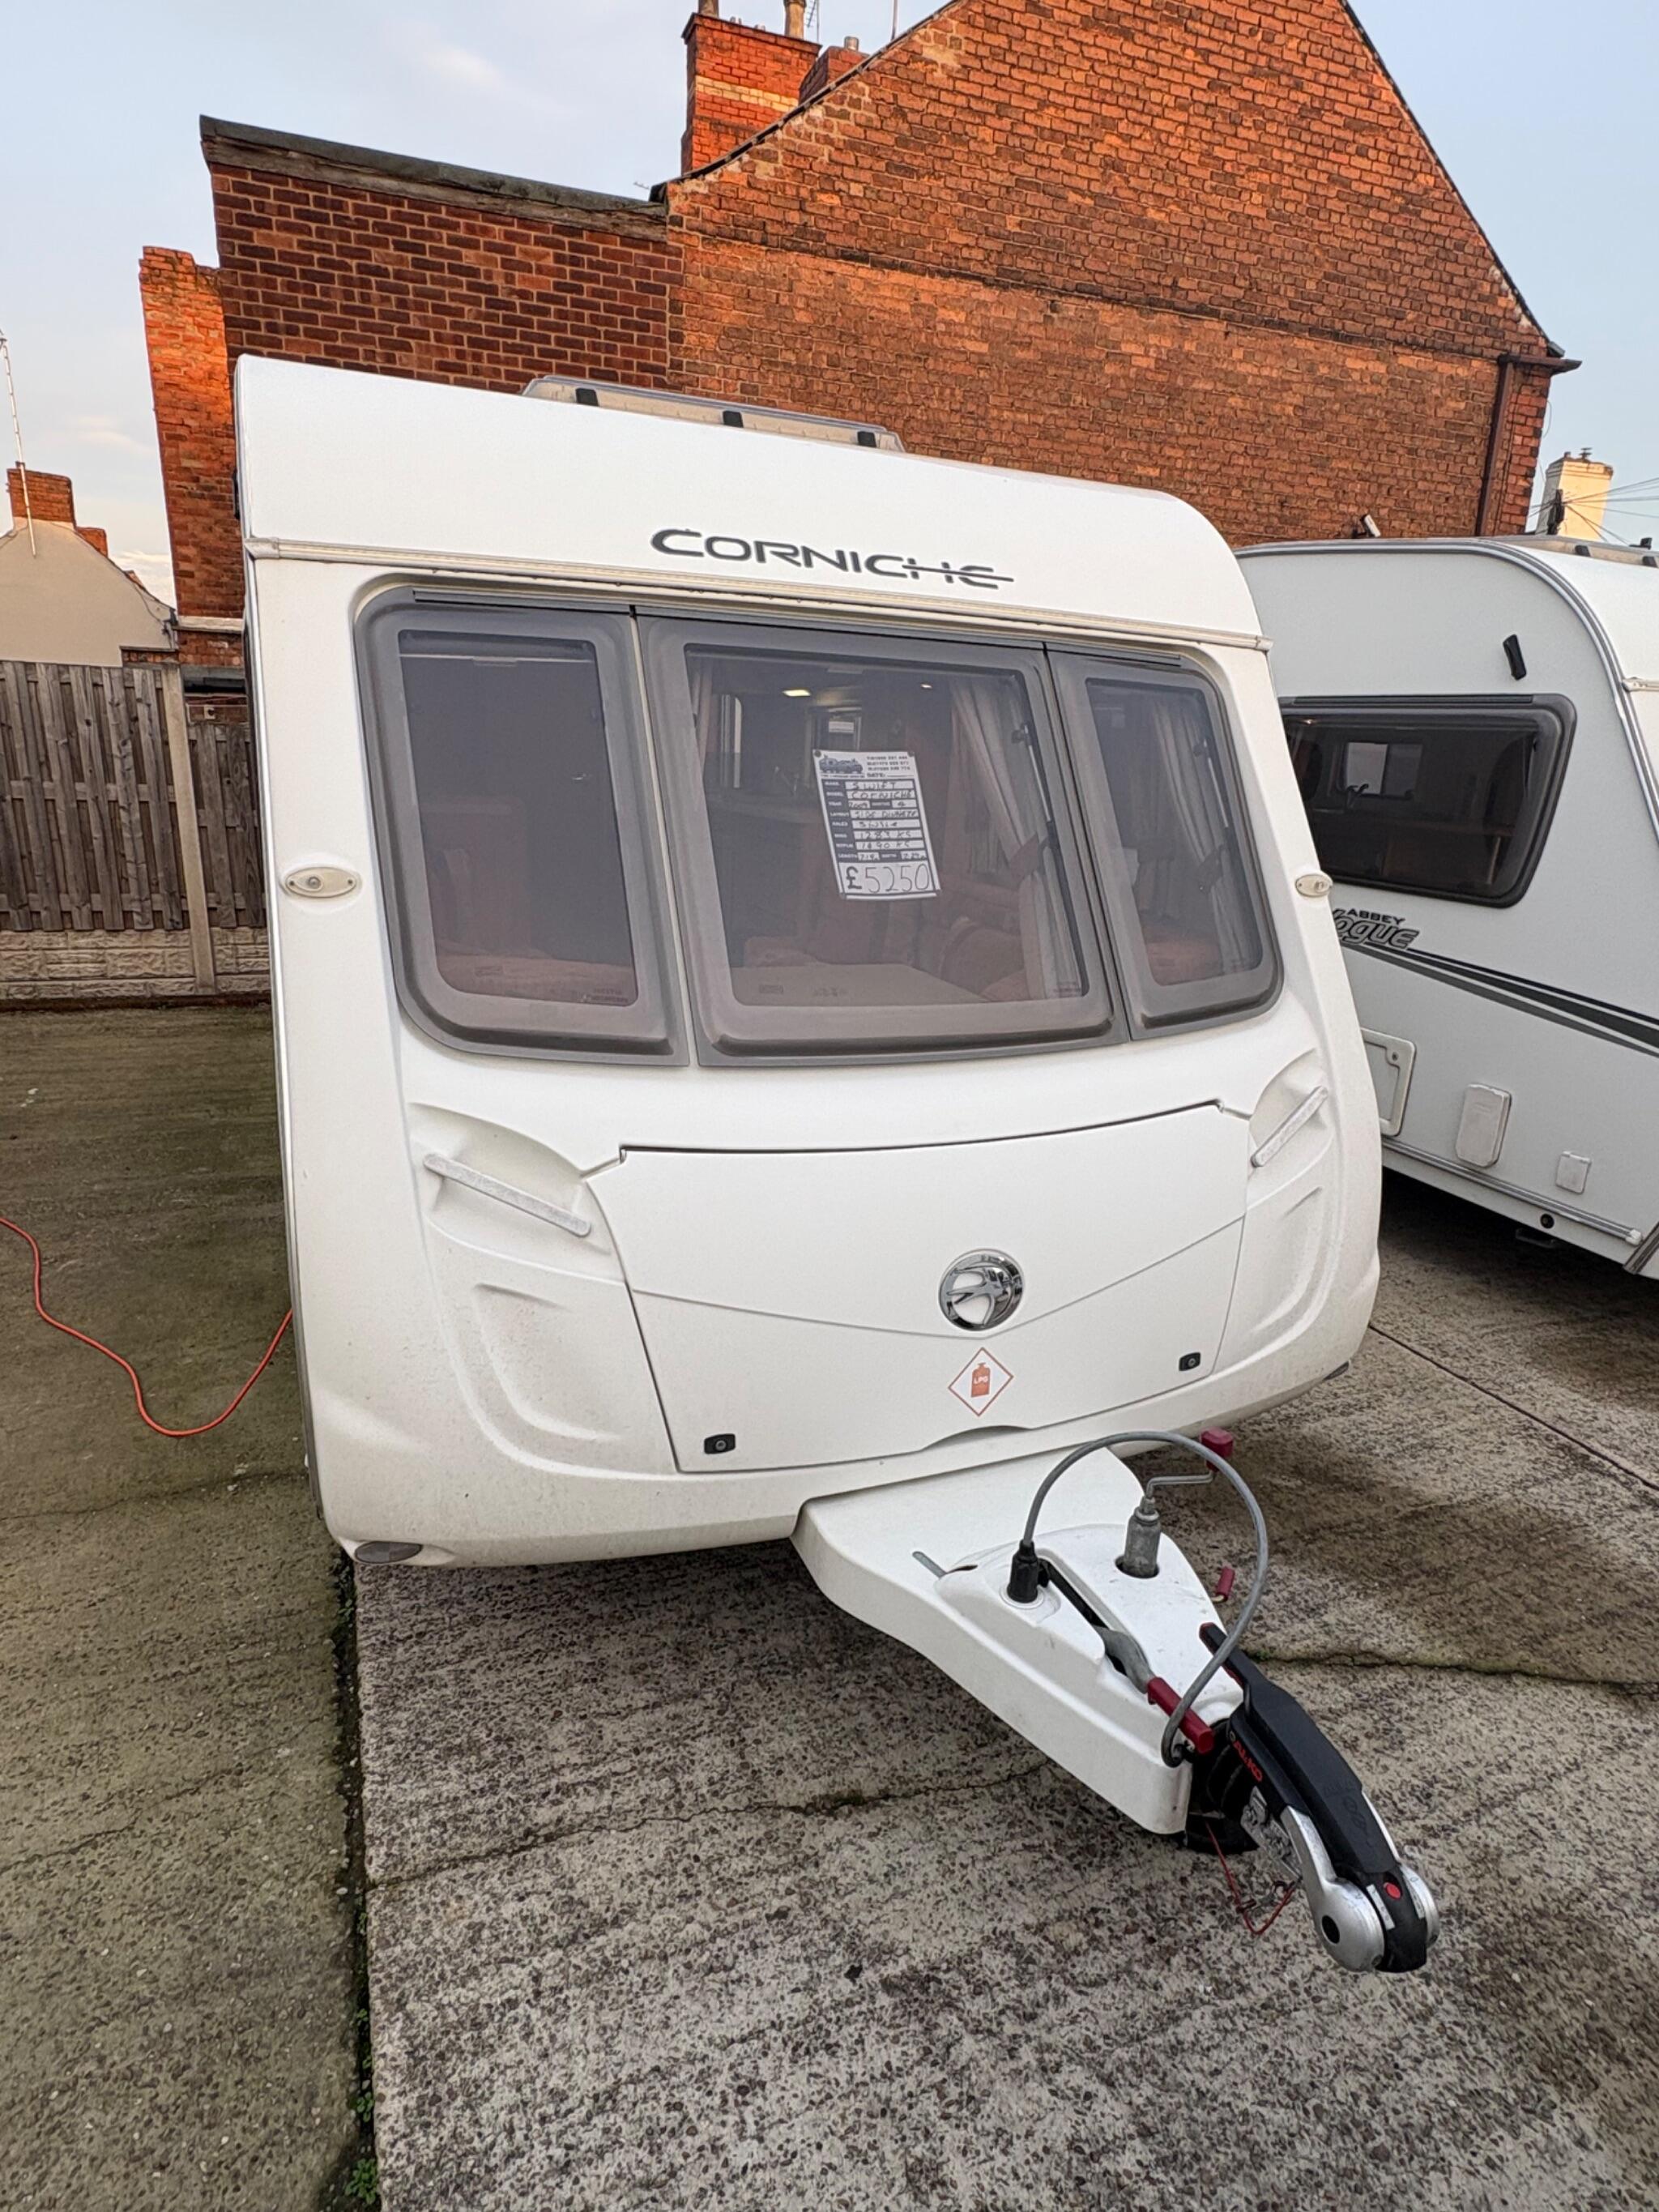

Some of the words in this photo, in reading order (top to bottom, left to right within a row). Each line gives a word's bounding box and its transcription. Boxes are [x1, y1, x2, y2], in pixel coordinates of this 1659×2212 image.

[650, 528, 1013, 590] CORNICHE
[847, 863, 929, 894] £5250
[1346, 908, 1405, 925] ABBEY
